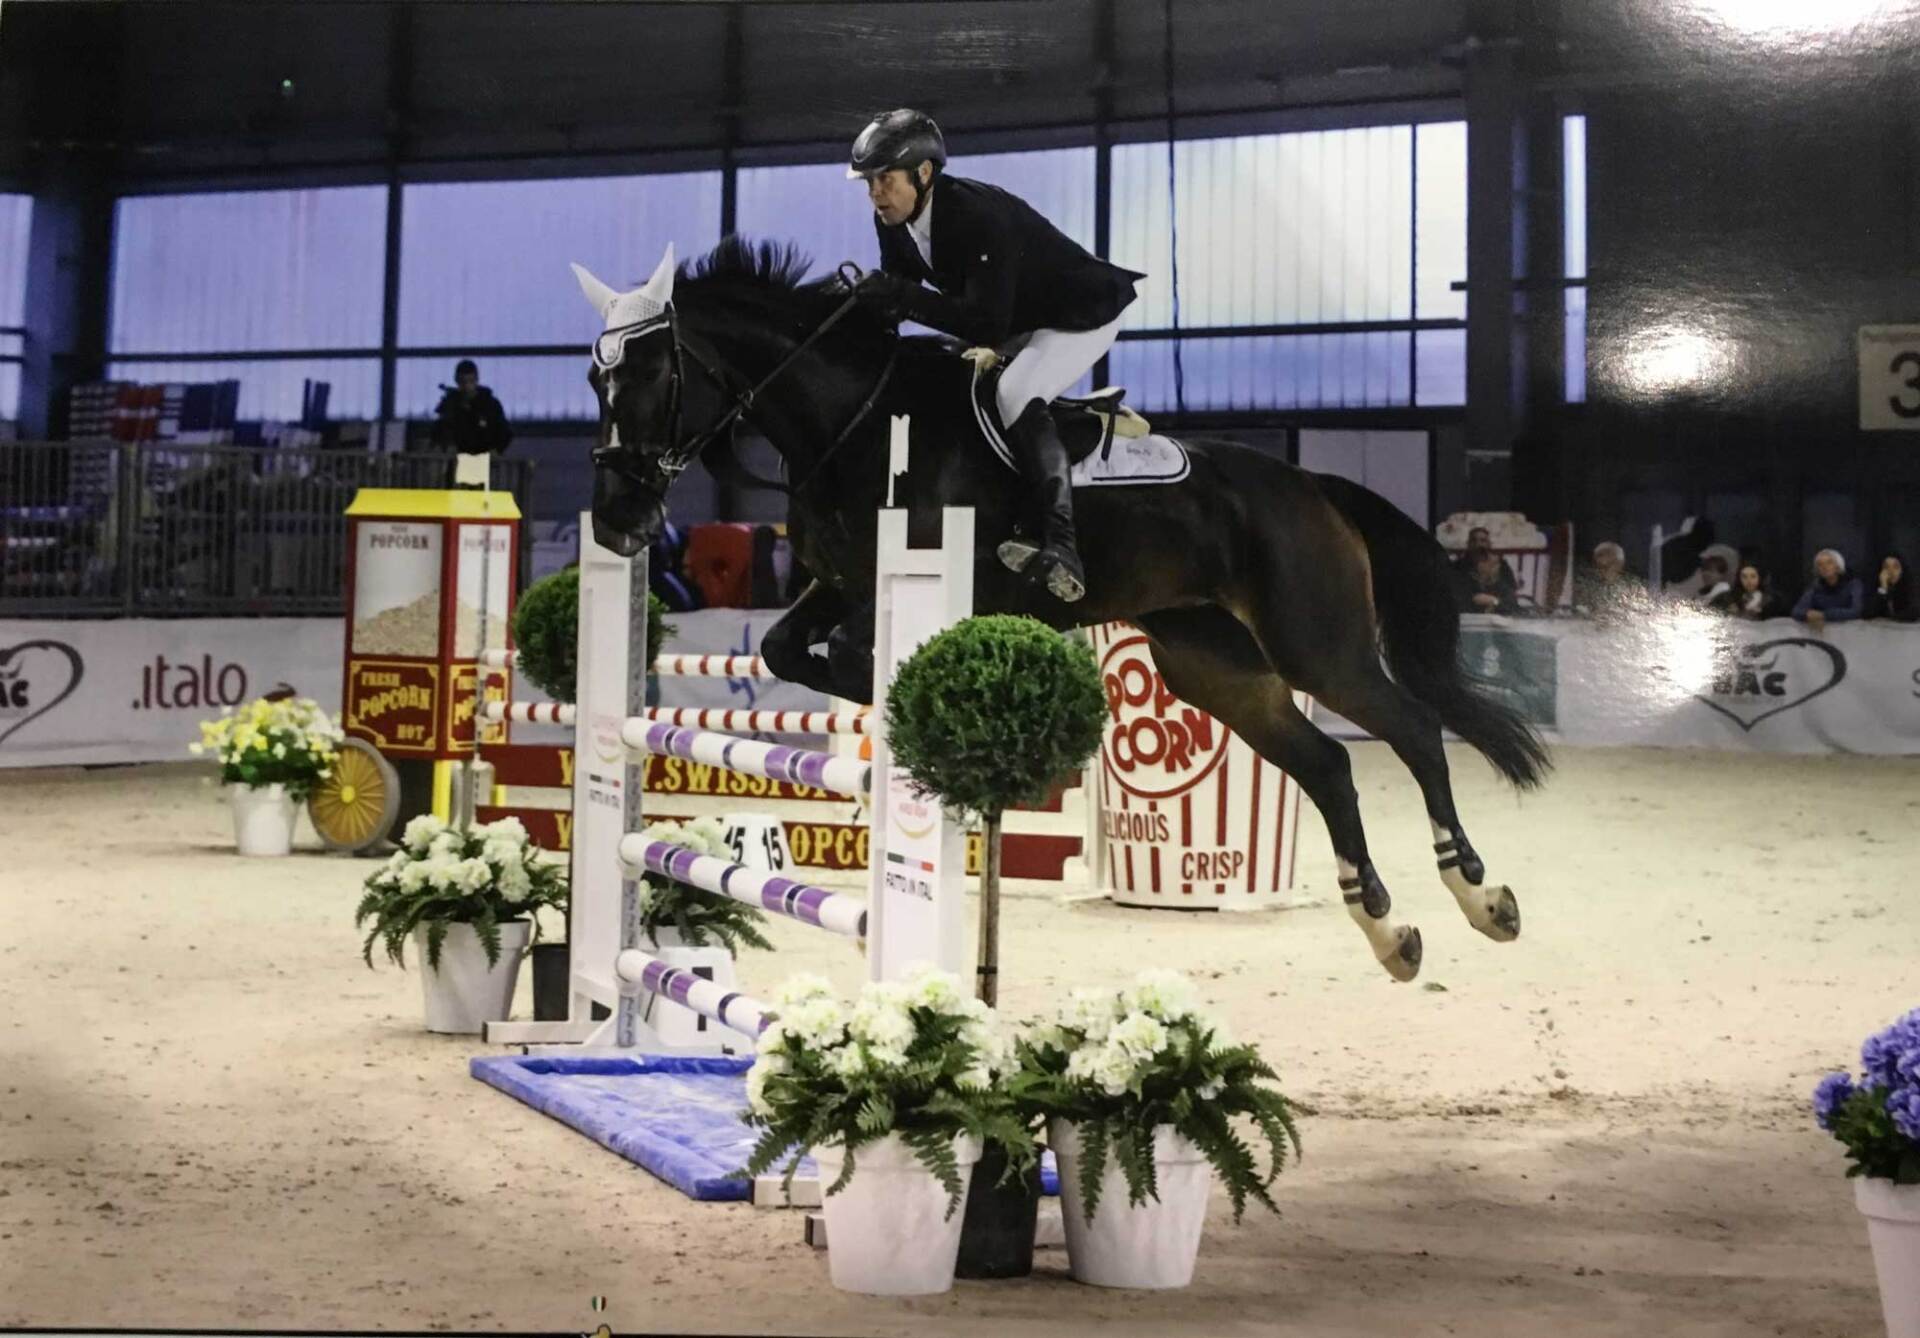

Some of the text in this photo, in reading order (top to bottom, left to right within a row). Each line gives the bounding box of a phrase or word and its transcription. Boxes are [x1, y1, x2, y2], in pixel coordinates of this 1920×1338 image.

[369, 534, 429, 550] POPCORN
[361, 671, 400, 687] FRESH
[1104, 658, 1177, 723] POP
[359, 684, 430, 720] POPCORN
[397, 723, 425, 741] HOT
[1112, 708, 1212, 773] CORN
[761, 826, 784, 871] 15
[1181, 850, 1245, 882] CRISP
